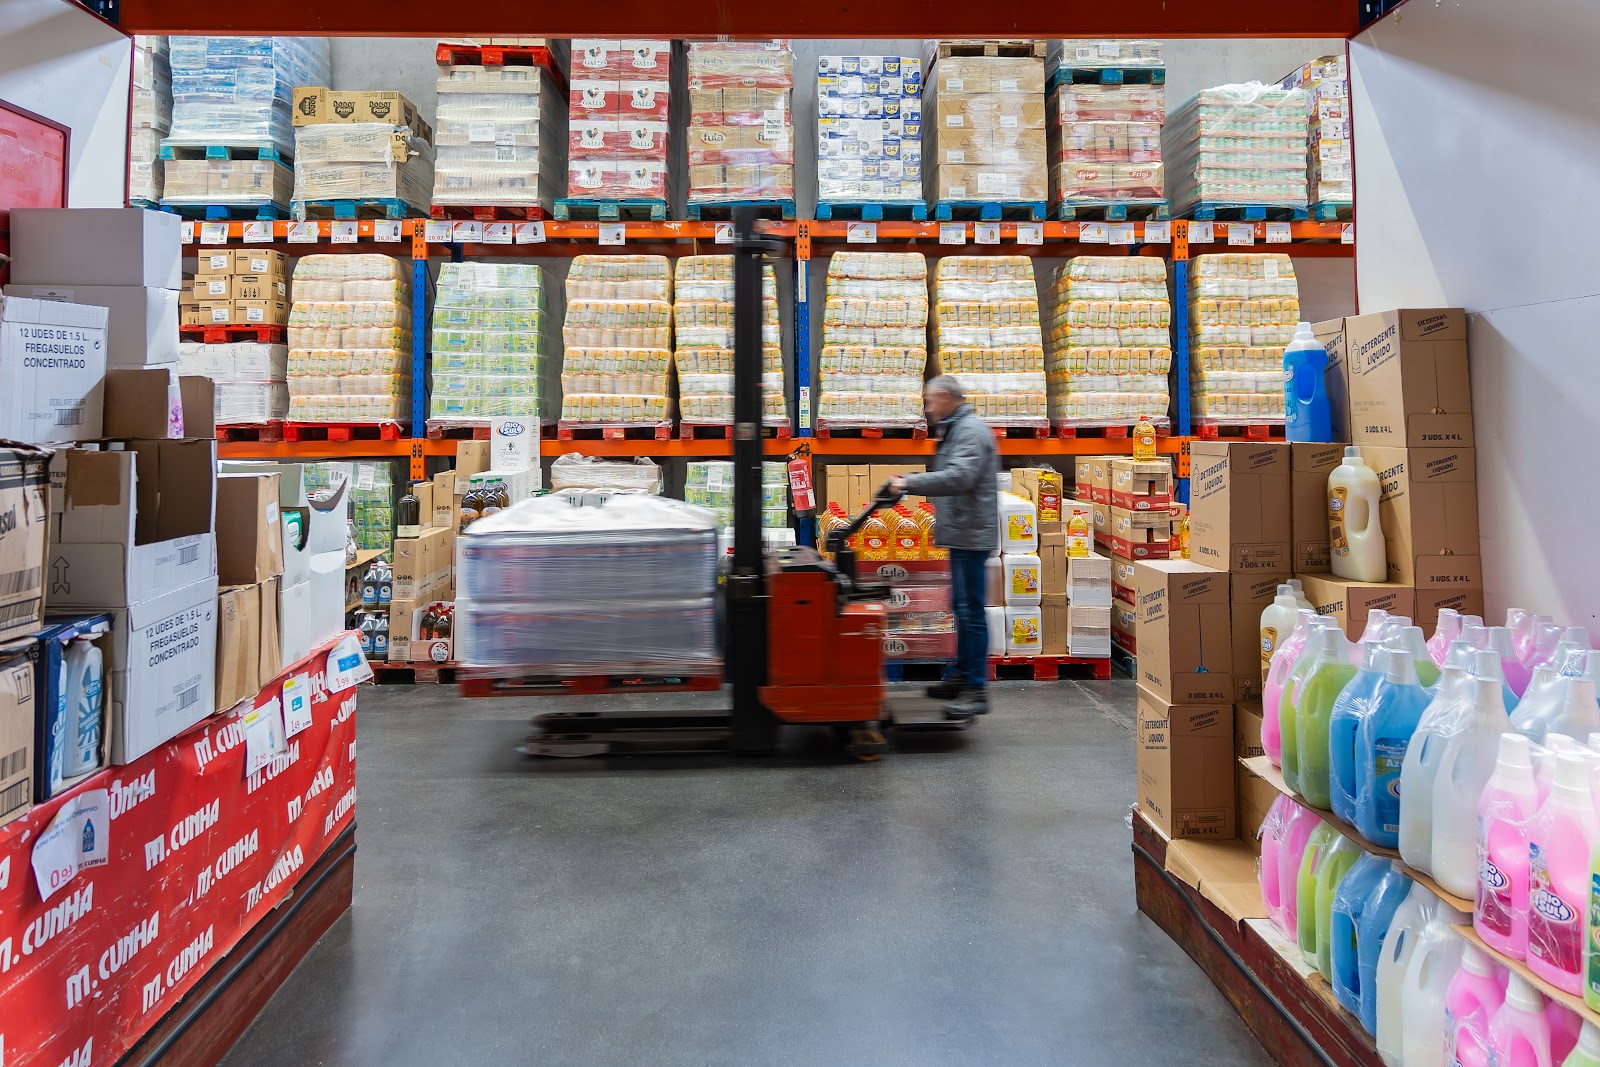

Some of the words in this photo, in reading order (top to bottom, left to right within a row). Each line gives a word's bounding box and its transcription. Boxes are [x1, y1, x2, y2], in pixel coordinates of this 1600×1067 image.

[886, 63, 897, 71] 64
[906, 84, 917, 92] 64
[1078, 171, 1096, 179] Frigi
[20, 328, 29, 338] 12
[32, 329, 54, 339] UDES
[56, 330, 68, 340] DE
[70, 332, 81, 341] 1.5
[1360, 325, 1396, 355] DETERGENTE
[25, 343, 85, 355] FREGASUELOS
[1367, 343, 1391, 366] LIQUIDO
[24, 358, 86, 369] CONCENTRADO
[503, 427, 520, 435] SUL
[1426, 454, 1458, 468] DETERGENTE
[1200, 458, 1228, 480] DETERGENTE
[1432, 463, 1454, 474] LIQUIDO
[1204, 475, 1223, 491] LIQUIDO
[880, 566, 905, 578] fula
[1183, 577, 1212, 590] DETERGENTE
[1188, 585, 1208, 594] LIQUIDO
[1143, 588, 1166, 605] DETERGENTE
[1365, 593, 1397, 607] DETERGENTE
[1434, 594, 1466, 608] DETERGENTE
[1147, 603, 1163, 617] LIQUIDO
[145, 627, 154, 639] 12
[156, 620, 173, 636] UDES
[174, 616, 185, 629] DE
[185, 613, 195, 626] 1.5
[150, 623, 199, 653] FREGASUELOS
[149, 636, 200, 668] CONCENTRADO
[884, 641, 905, 652] ula
[1145, 720, 1168, 729] DETERGENTE
[194, 717, 247, 768] M.CUN
[1148, 733, 1165, 744] LIQUIDO
[1181, 827, 1185, 835] 3
[1541, 889, 1562, 907] RIO
[1537, 902, 1563, 920] SUL
